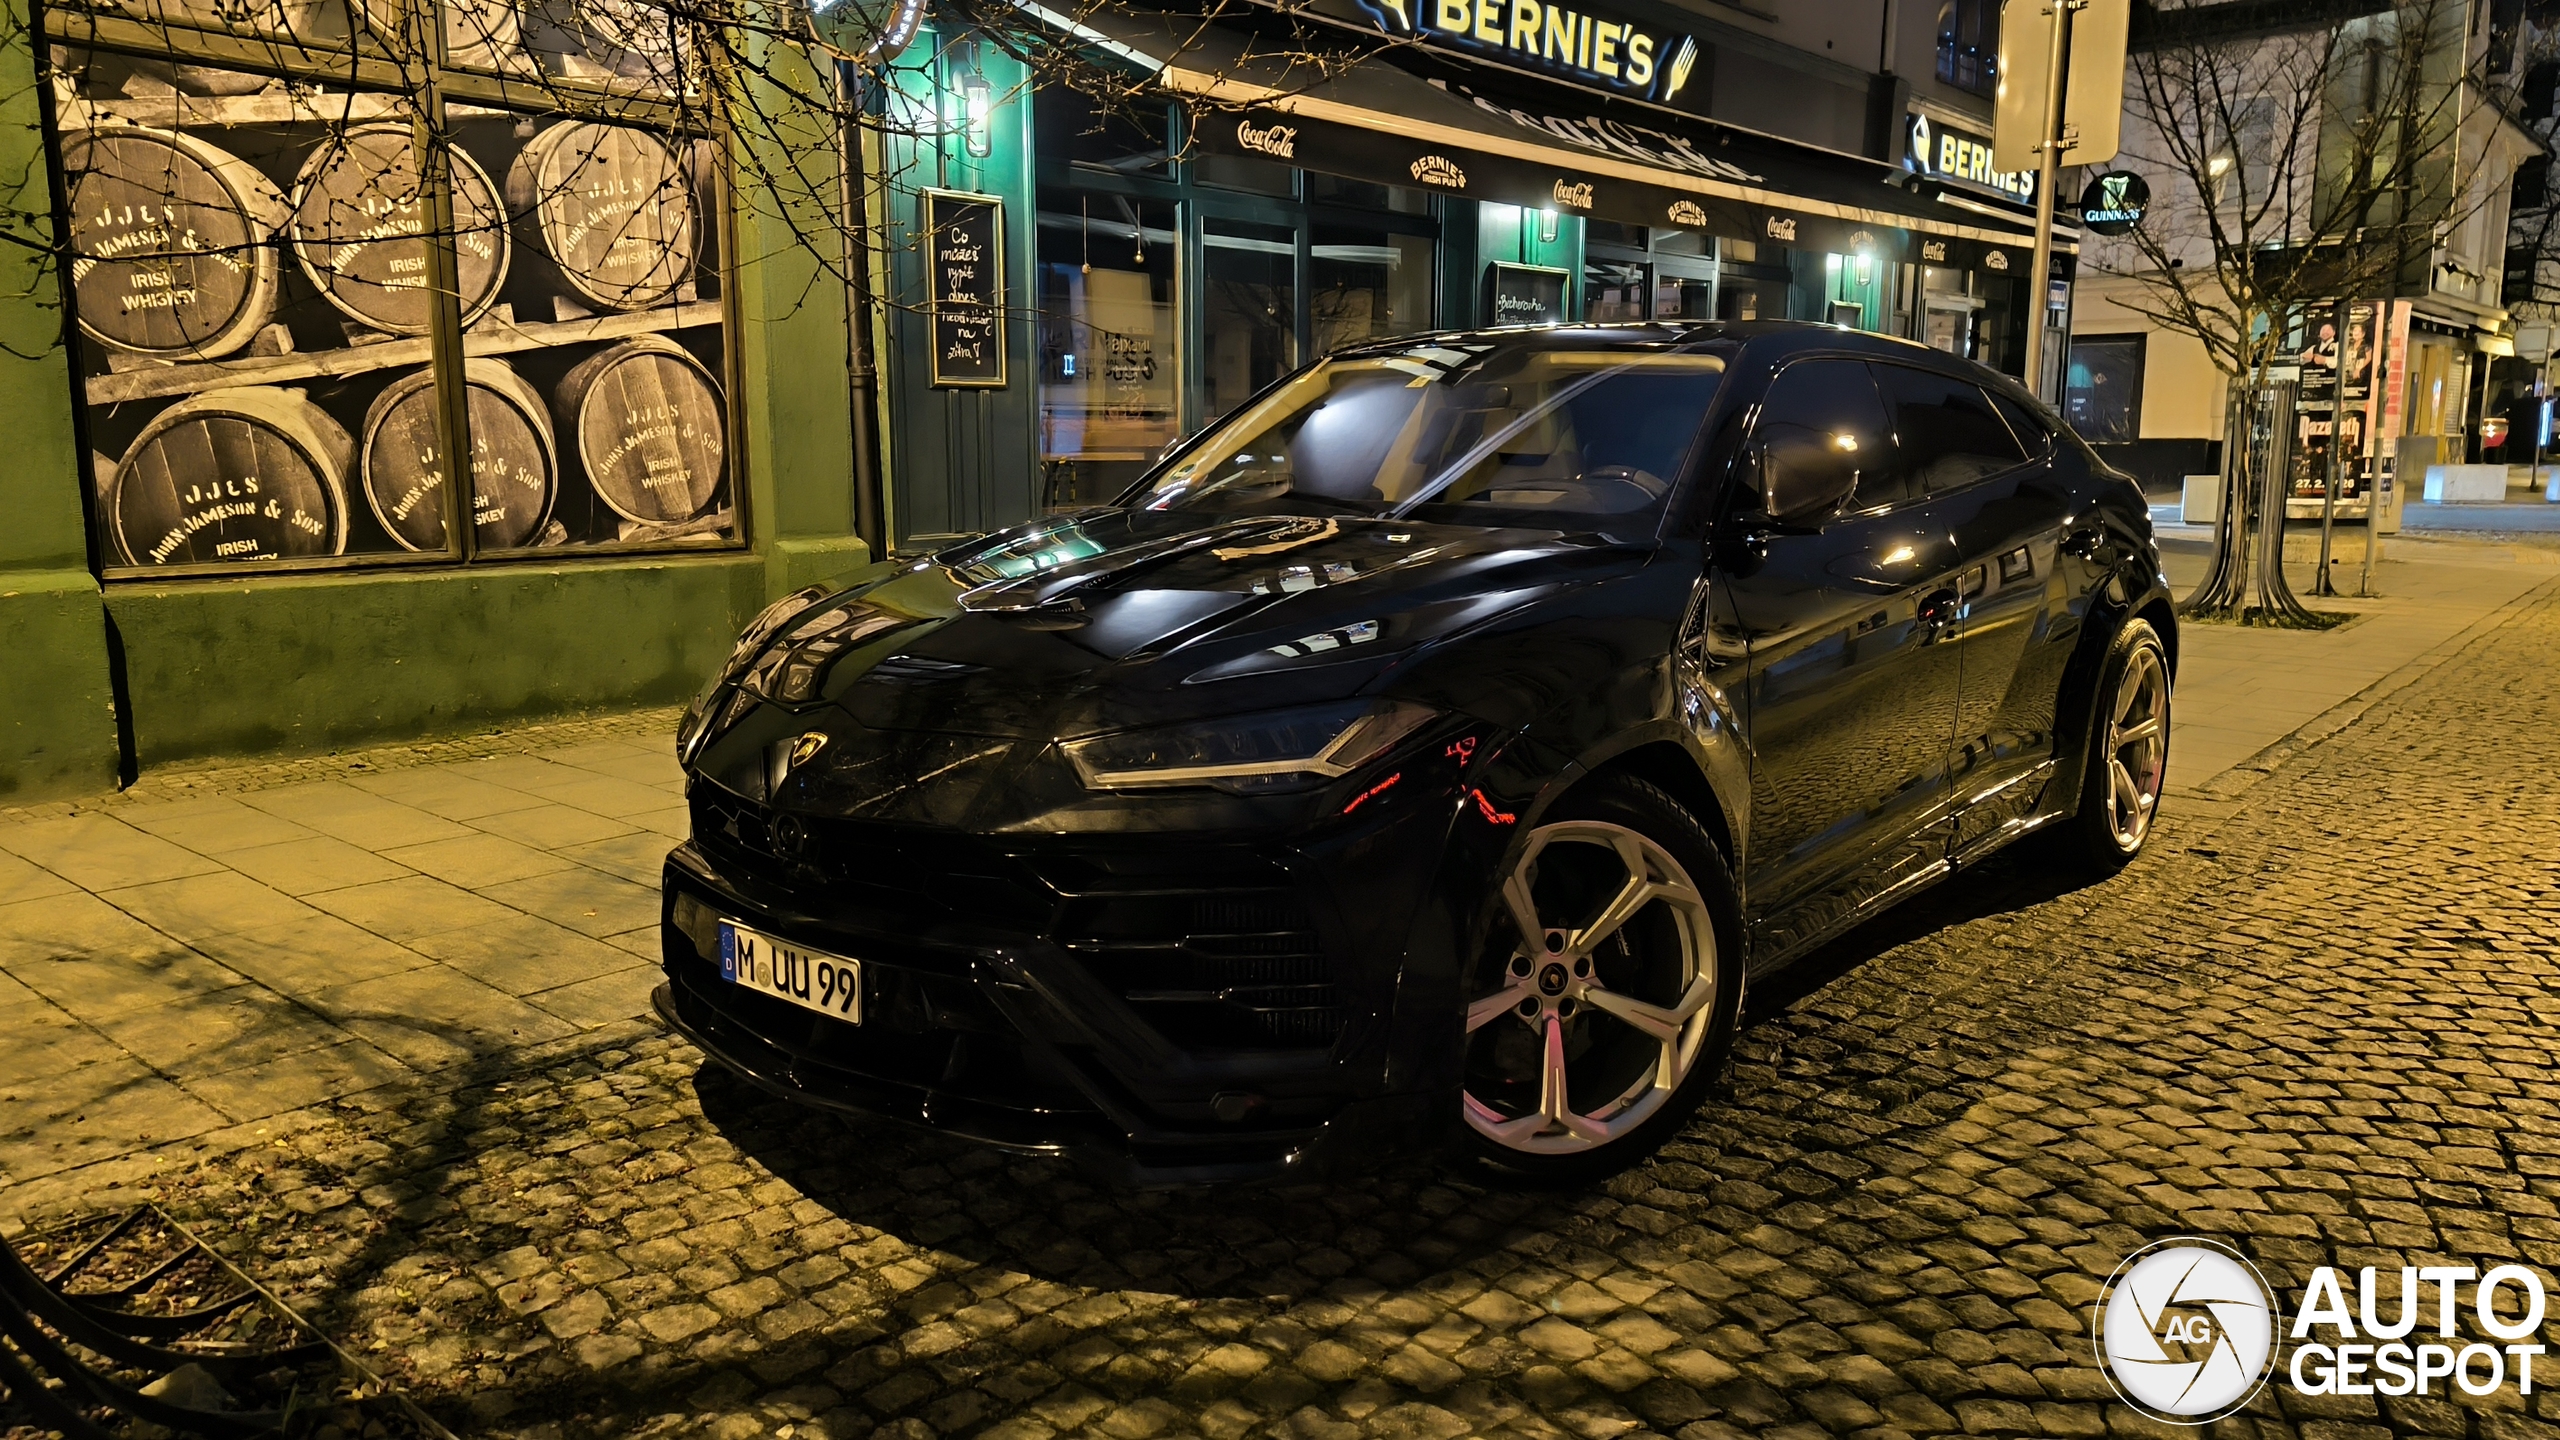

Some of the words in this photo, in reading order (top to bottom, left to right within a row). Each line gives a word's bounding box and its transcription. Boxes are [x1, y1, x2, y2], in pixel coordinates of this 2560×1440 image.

[1436, 0, 1655, 86] BERNIE'S
[1237, 120, 1297, 159] Coca-Cola
[1410, 155, 1467, 188] BERNIE'S
[1422, 173, 1441, 185] IRISH
[1442, 177, 1457, 187] PUB
[1553, 178, 1593, 209] Coca-Cola
[624, 425, 677, 451] JAMESON
[647, 457, 679, 472] IRISH
[641, 470, 692, 489] WHISKEY
[149, 528, 187, 564] JOHN
[183, 501, 257, 534] JAMESON
[291, 509, 324, 536] SON
[215, 538, 259, 557] IRISH
[725, 957, 733, 971] D
[736, 934, 756, 982] M
[817, 961, 857, 1013] 99
